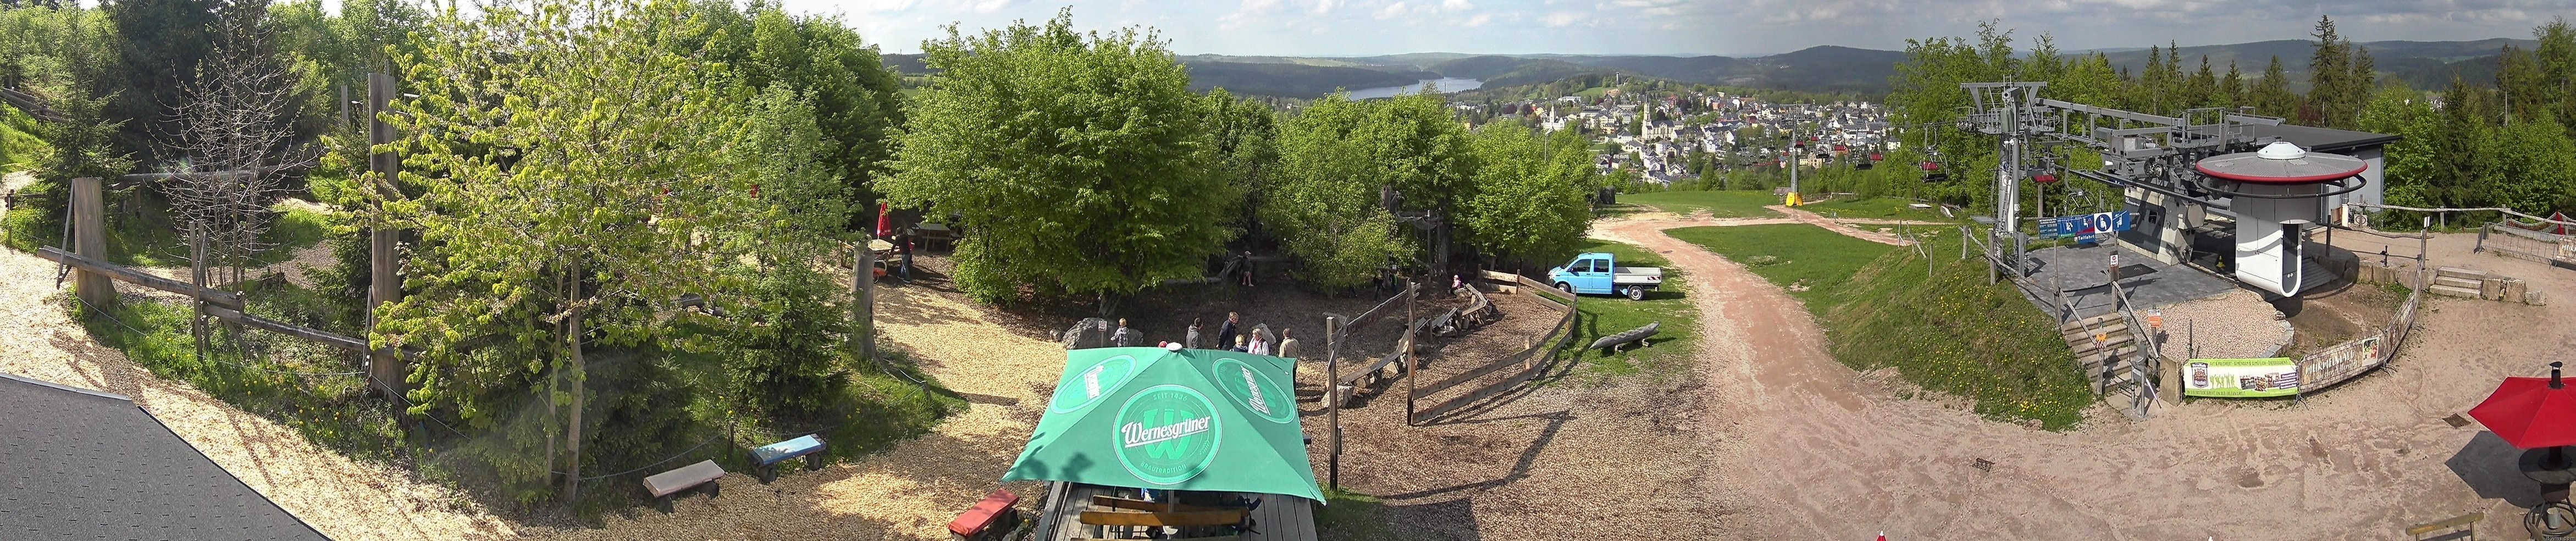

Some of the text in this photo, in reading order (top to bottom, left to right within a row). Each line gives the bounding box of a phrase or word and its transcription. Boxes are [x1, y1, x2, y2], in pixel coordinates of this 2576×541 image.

[1171, 393, 1187, 401] 1436
[1121, 416, 1210, 445] Wernesgrüner
[1141, 461, 1187, 474] BRAUTRADITION
